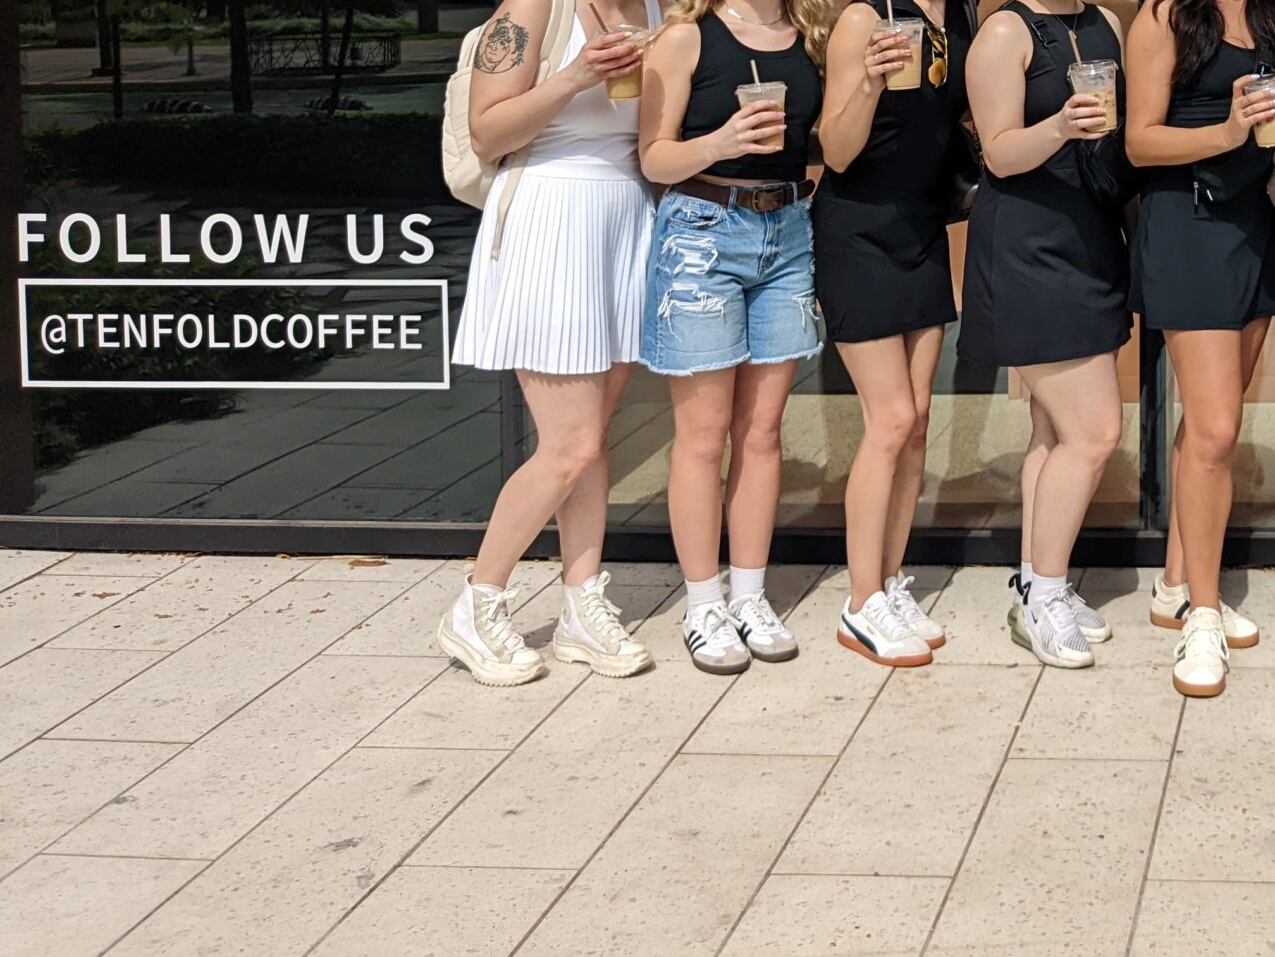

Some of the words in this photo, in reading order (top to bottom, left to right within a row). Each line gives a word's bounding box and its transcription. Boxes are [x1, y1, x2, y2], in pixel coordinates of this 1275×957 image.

[18, 212, 309, 264] FOLLOW
[346, 213, 434, 265] US
[41, 313, 423, 355] @TENFOLDCOFFEE
